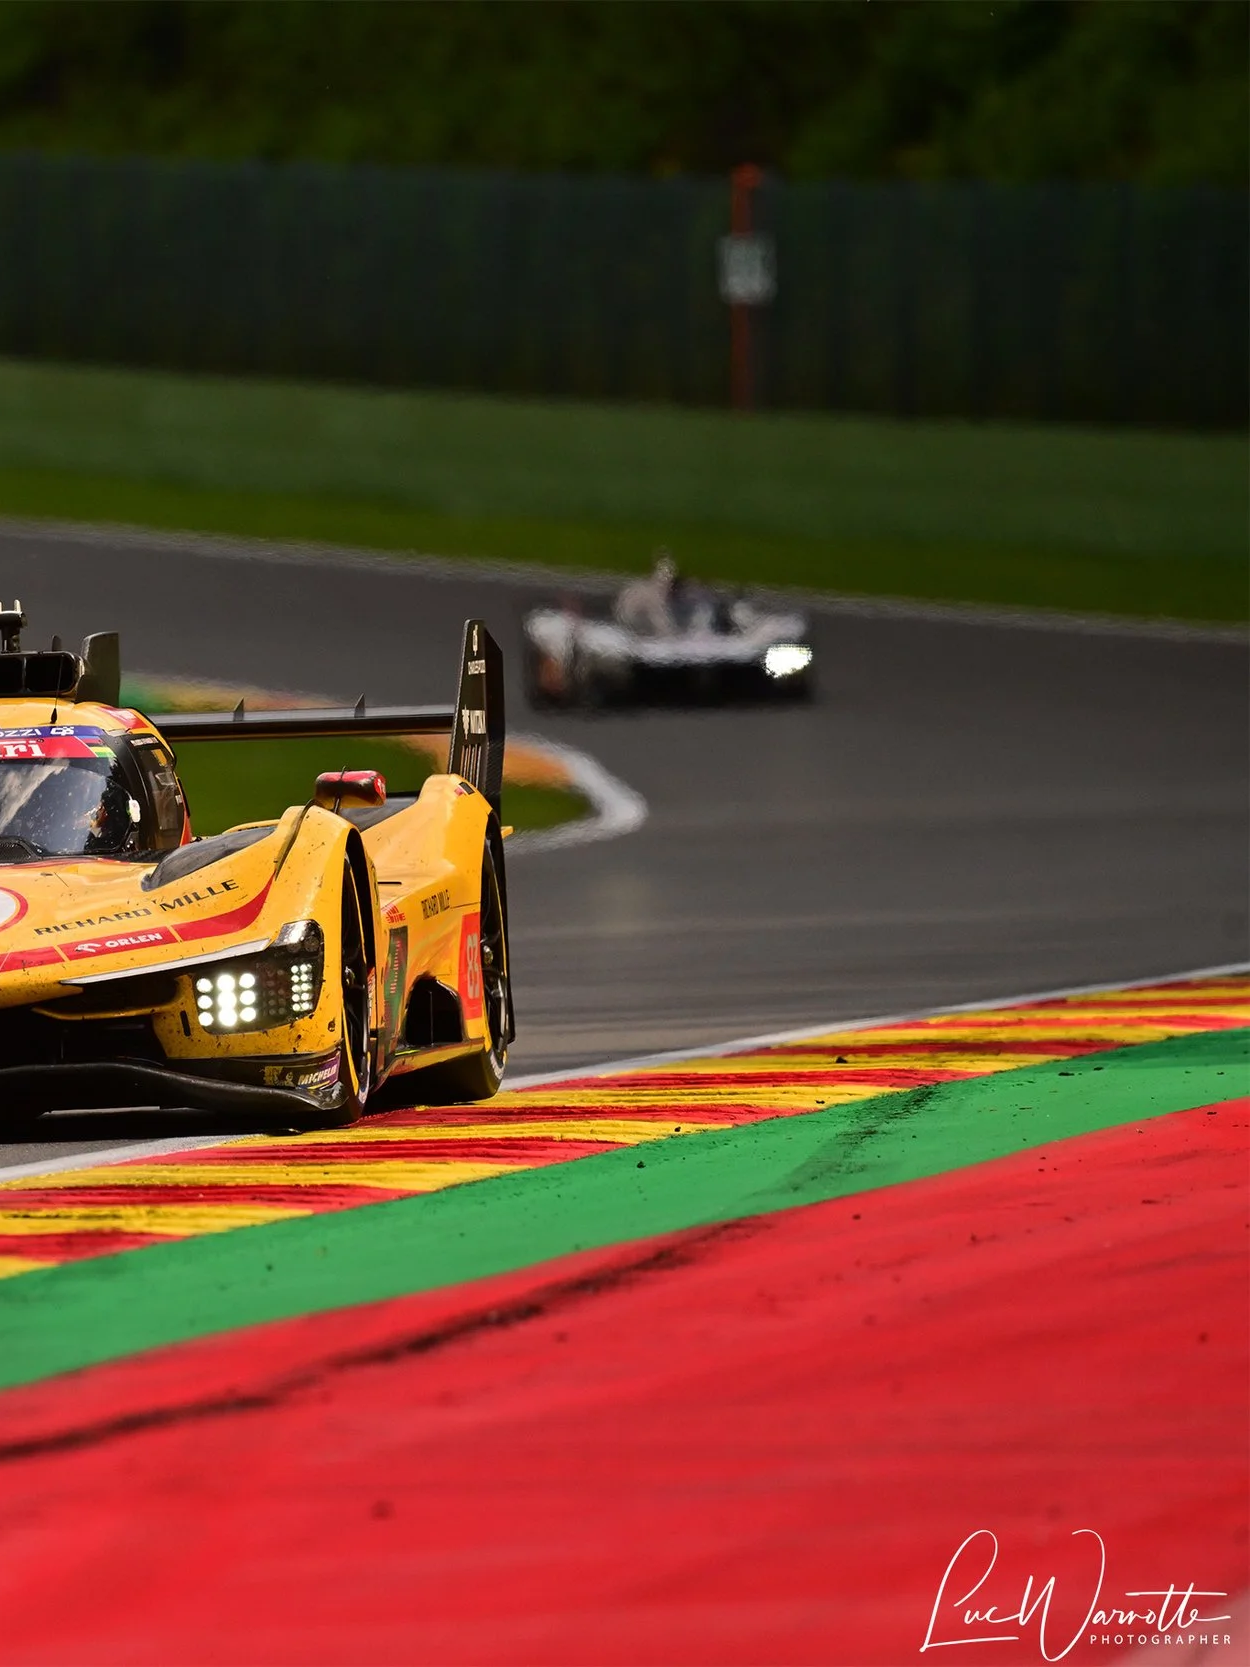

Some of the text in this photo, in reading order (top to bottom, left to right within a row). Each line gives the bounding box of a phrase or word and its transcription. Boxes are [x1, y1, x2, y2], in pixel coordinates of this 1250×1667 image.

[33, 879, 239, 936] RICHARD MILLE
[104, 932, 163, 948] ORLEN
[297, 1064, 338, 1086] MICHELIN
